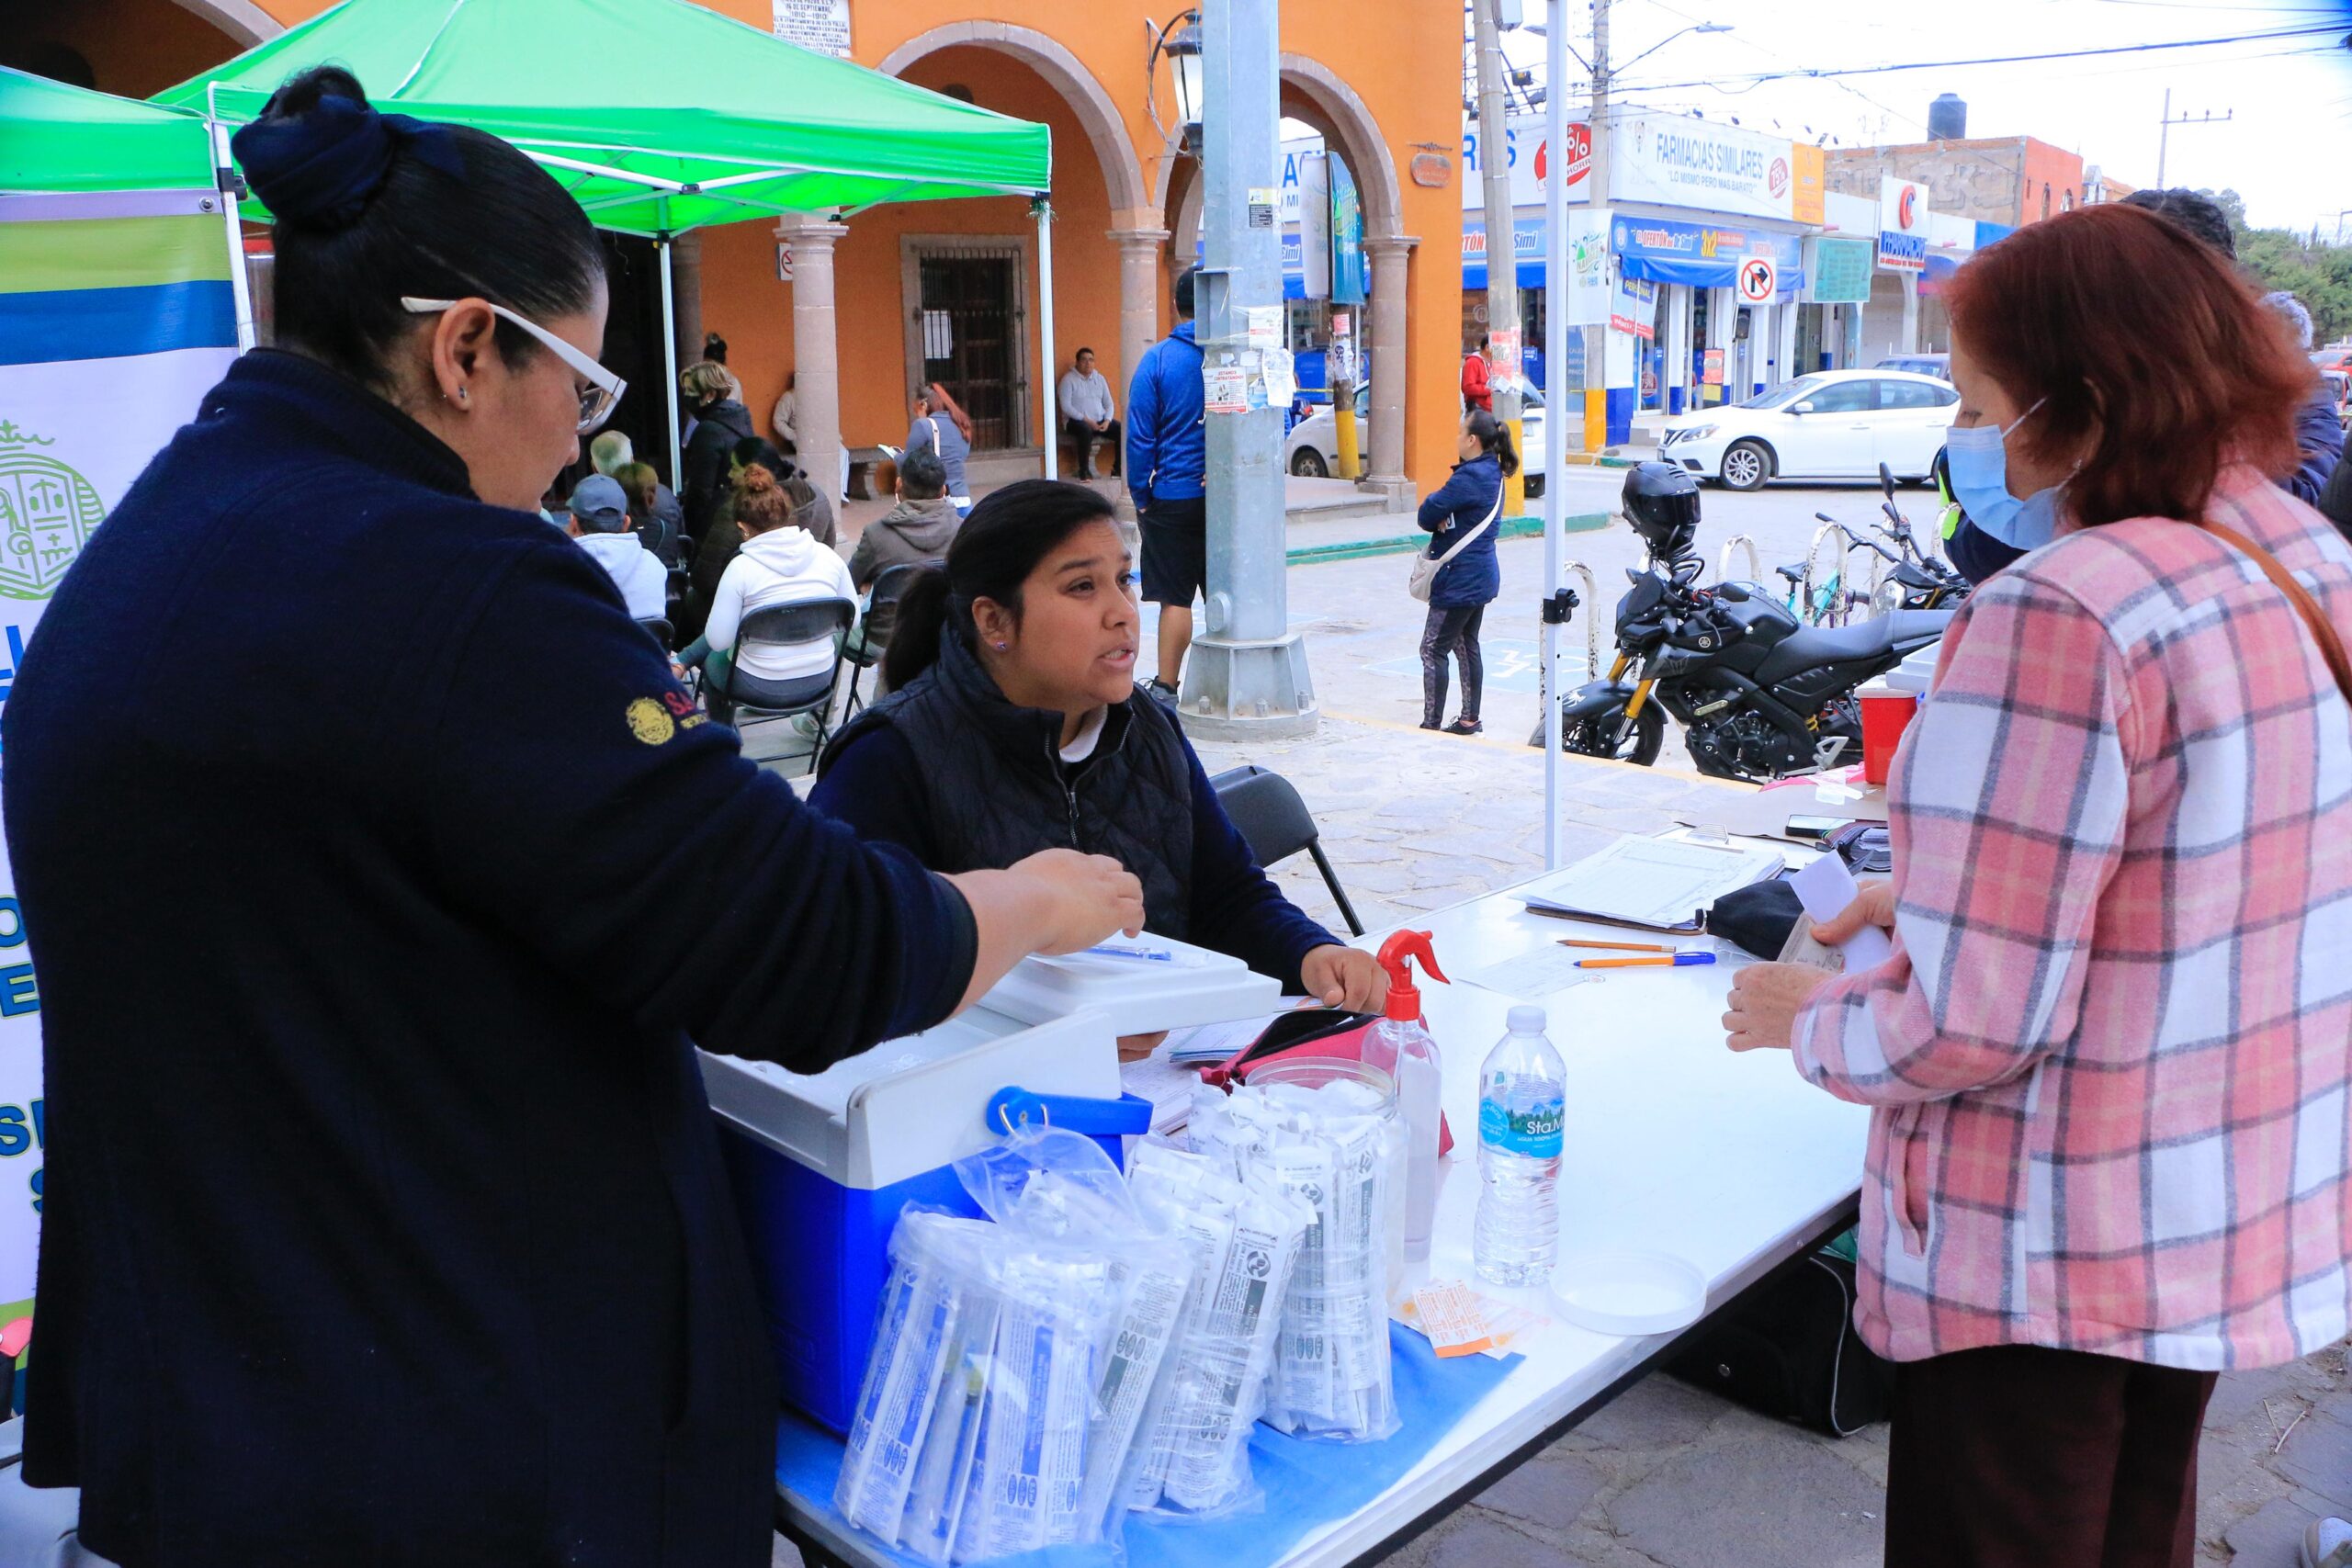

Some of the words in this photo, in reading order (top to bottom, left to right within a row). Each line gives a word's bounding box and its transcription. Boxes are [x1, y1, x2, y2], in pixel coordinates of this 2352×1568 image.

[1657, 132, 1714, 172] FARMACIAS
[1715, 141, 1764, 180] SIMILARES
[1680, 172, 1701, 186] MISMO
[1702, 175, 1717, 189] PERO
[1624, 280, 1651, 299] PERSNAL
[1526, 1116, 1564, 1135] Sta.M
